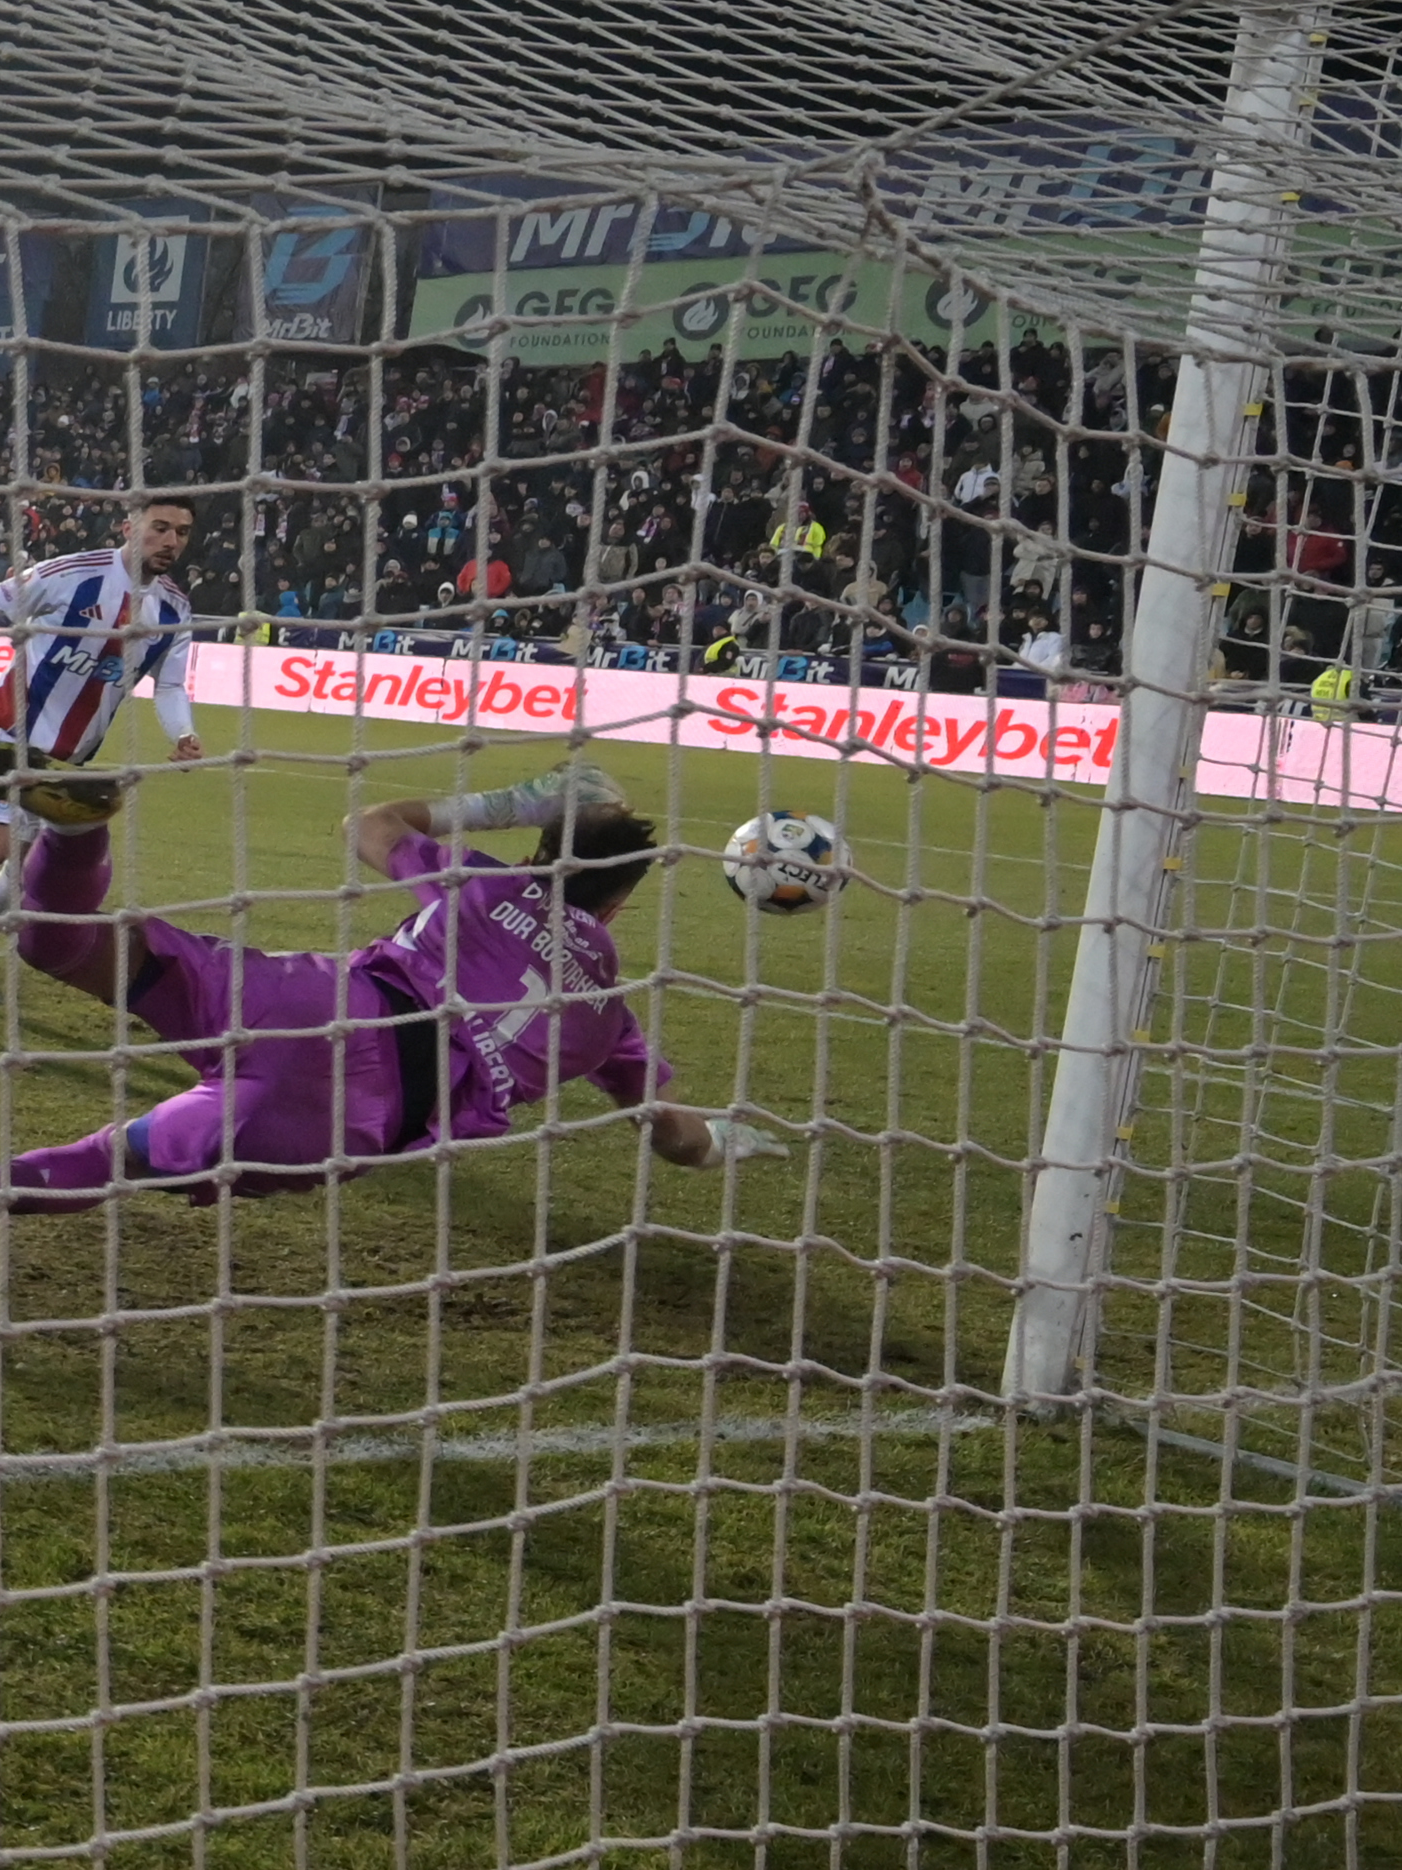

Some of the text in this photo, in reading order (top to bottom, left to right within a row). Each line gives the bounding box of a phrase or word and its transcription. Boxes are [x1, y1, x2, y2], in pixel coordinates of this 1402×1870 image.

[338, 629, 415, 656] MrBit
[451, 635, 538, 664] MrBit
[584, 645, 671, 673] MrBit
[274, 656, 588, 721] Stanleybet
[708, 686, 1120, 767] Stanleybet
